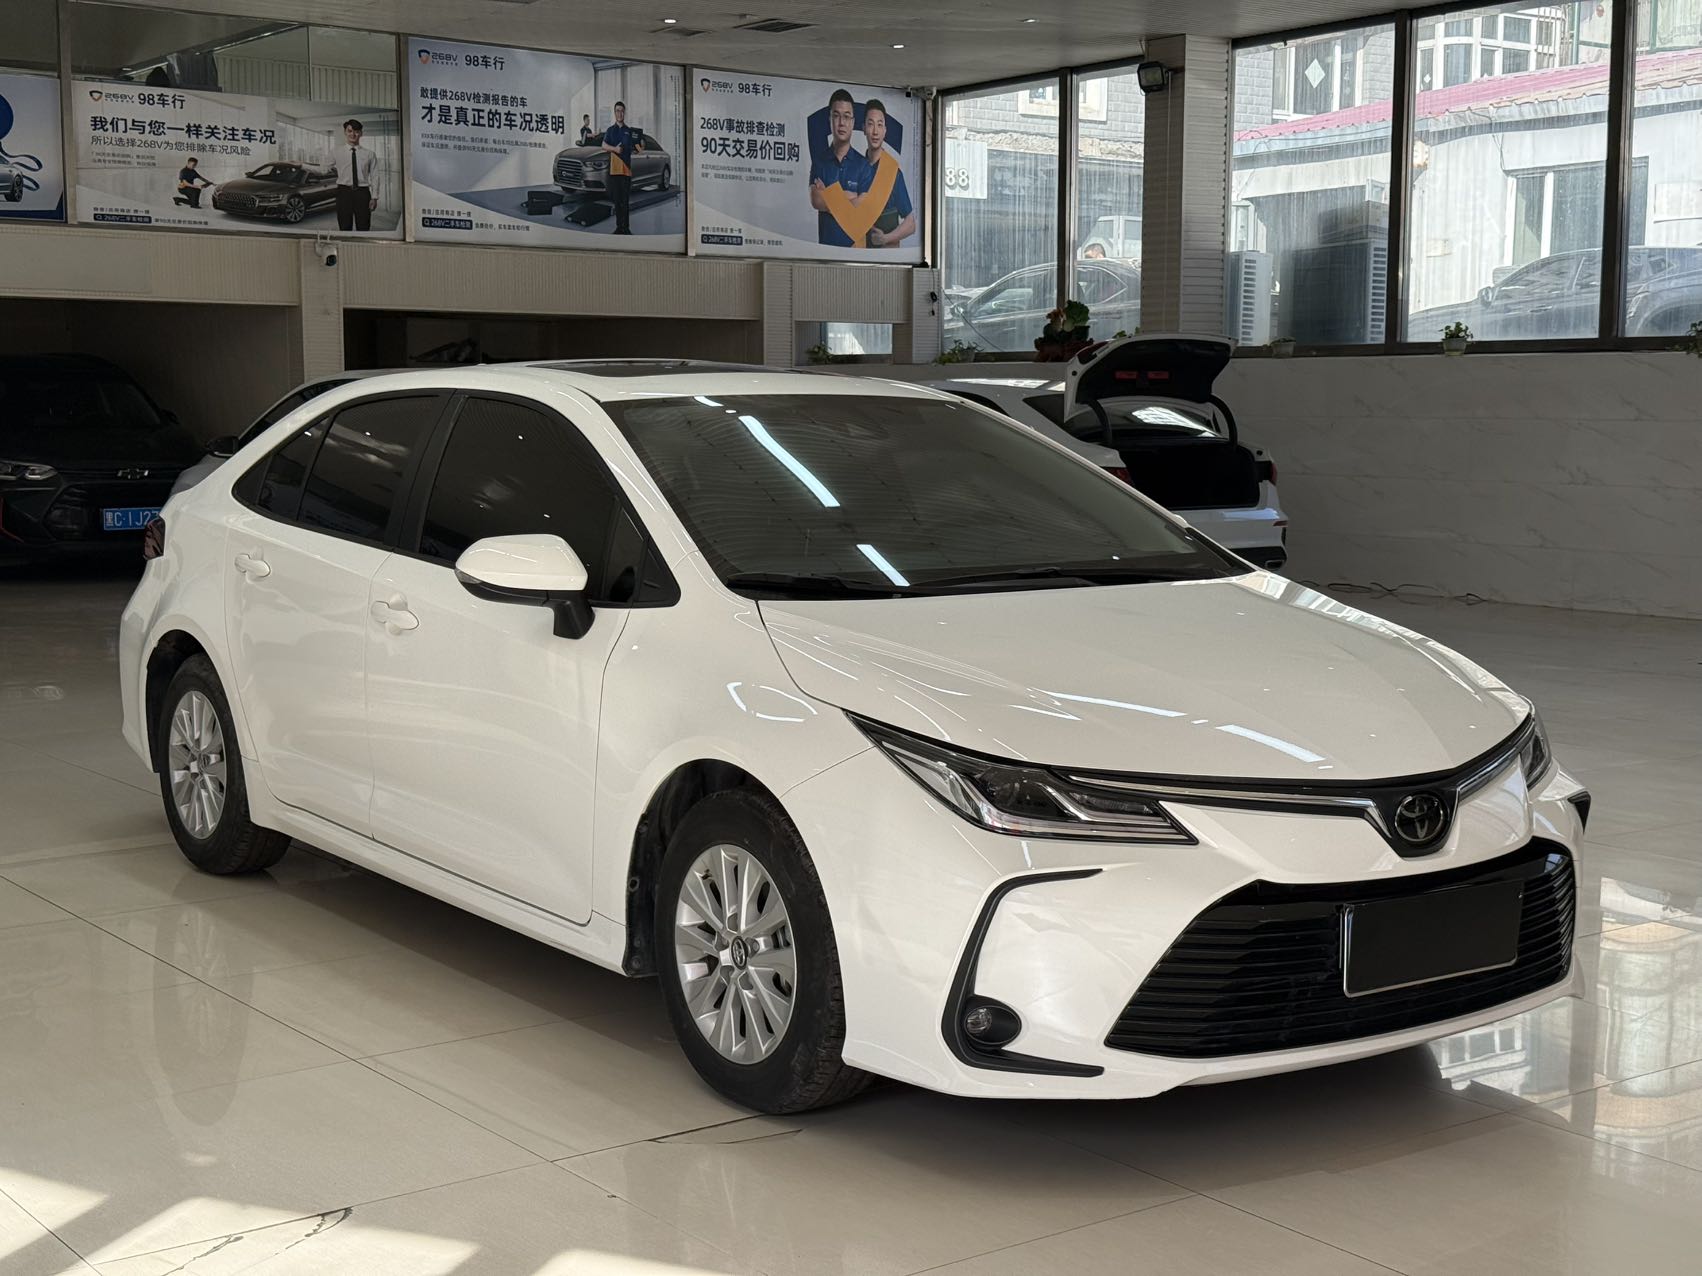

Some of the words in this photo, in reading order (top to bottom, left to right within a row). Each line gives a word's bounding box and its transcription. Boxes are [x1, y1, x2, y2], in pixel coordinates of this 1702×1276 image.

[431, 52, 458, 62] 268V
[464, 54, 505, 71] 98车行
[420, 86, 528, 109] 敢提供268V检测报告的车
[738, 82, 773, 97] 98车行
[138, 93, 186, 109] 98车行
[421, 103, 566, 135] 才是真正的车况透明
[700, 117, 786, 138] 268V事故排查检测
[90, 116, 277, 145] 我们与您一样关注车况
[91, 136, 251, 156] 所以选择268V为您排除车况风险
[701, 136, 800, 163] 90天交易价回购
